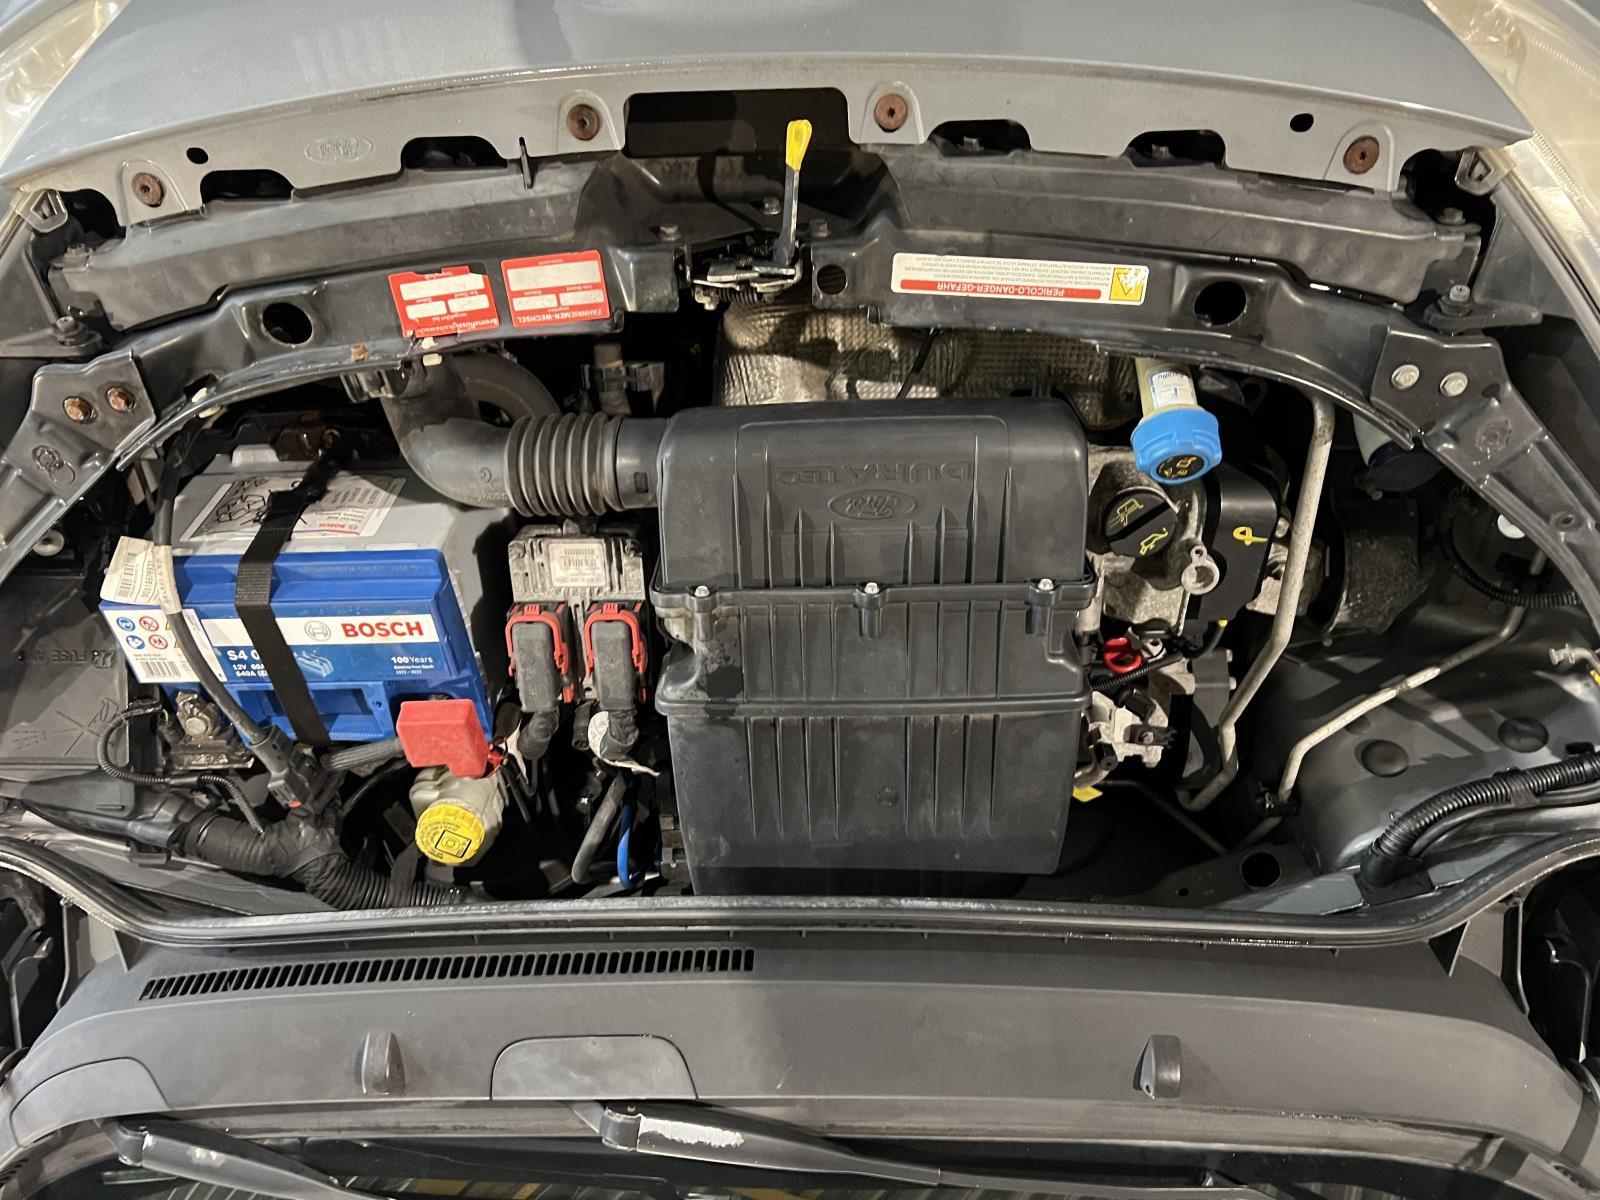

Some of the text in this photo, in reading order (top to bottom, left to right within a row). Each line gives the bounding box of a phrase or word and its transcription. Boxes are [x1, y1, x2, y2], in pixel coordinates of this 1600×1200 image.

[937, 281, 1064, 297] PERICOLO-DANGER-GEFAHR
[516, 308, 602, 323] ZAHNRIEMEN-WECHSEL
[777, 461, 971, 486] DURATEC
[341, 621, 424, 638] BOSCH
[226, 649, 248, 661] S4
[391, 656, 433, 664] 100 Years
